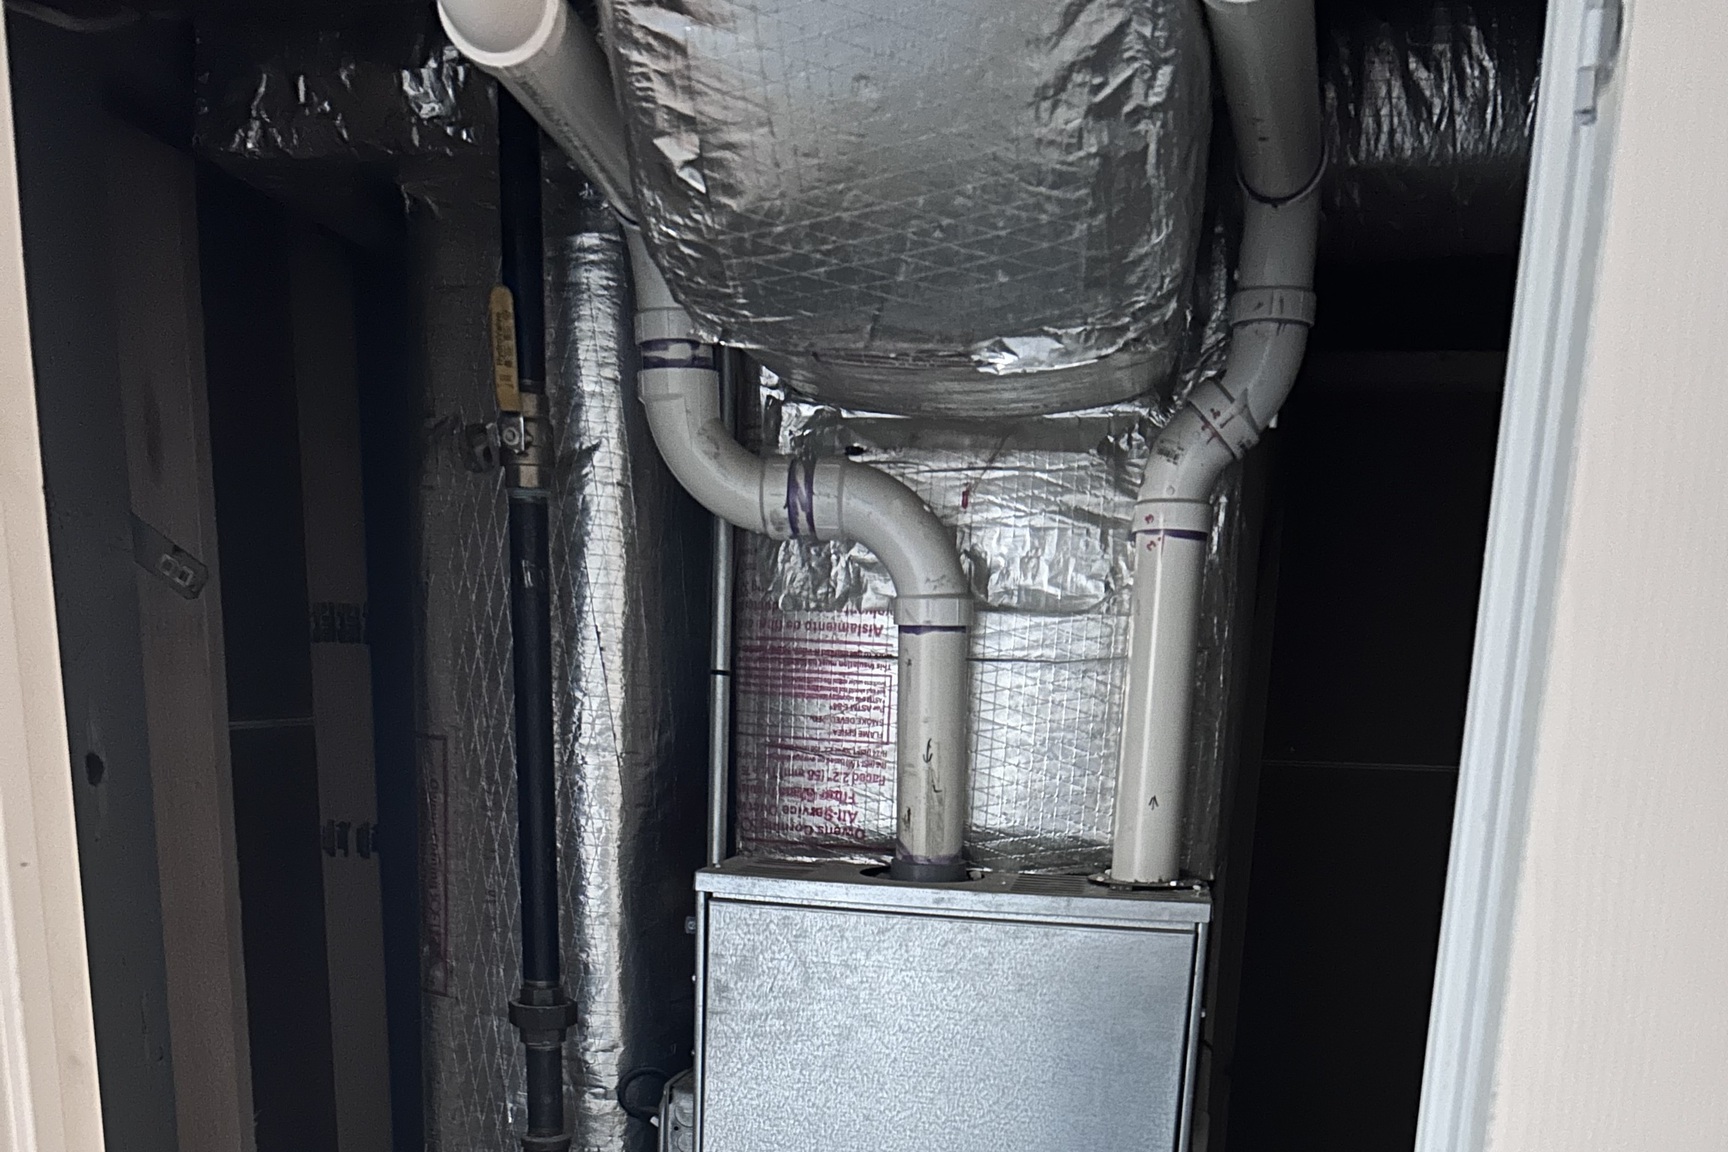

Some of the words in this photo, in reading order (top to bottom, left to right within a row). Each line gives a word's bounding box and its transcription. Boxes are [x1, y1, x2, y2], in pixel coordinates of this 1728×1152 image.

[806, 619, 884, 638] Aislamiento
[858, 729, 884, 739] FLAME
[782, 804, 858, 824] All-Service
[818, 823, 866, 841] Owens
